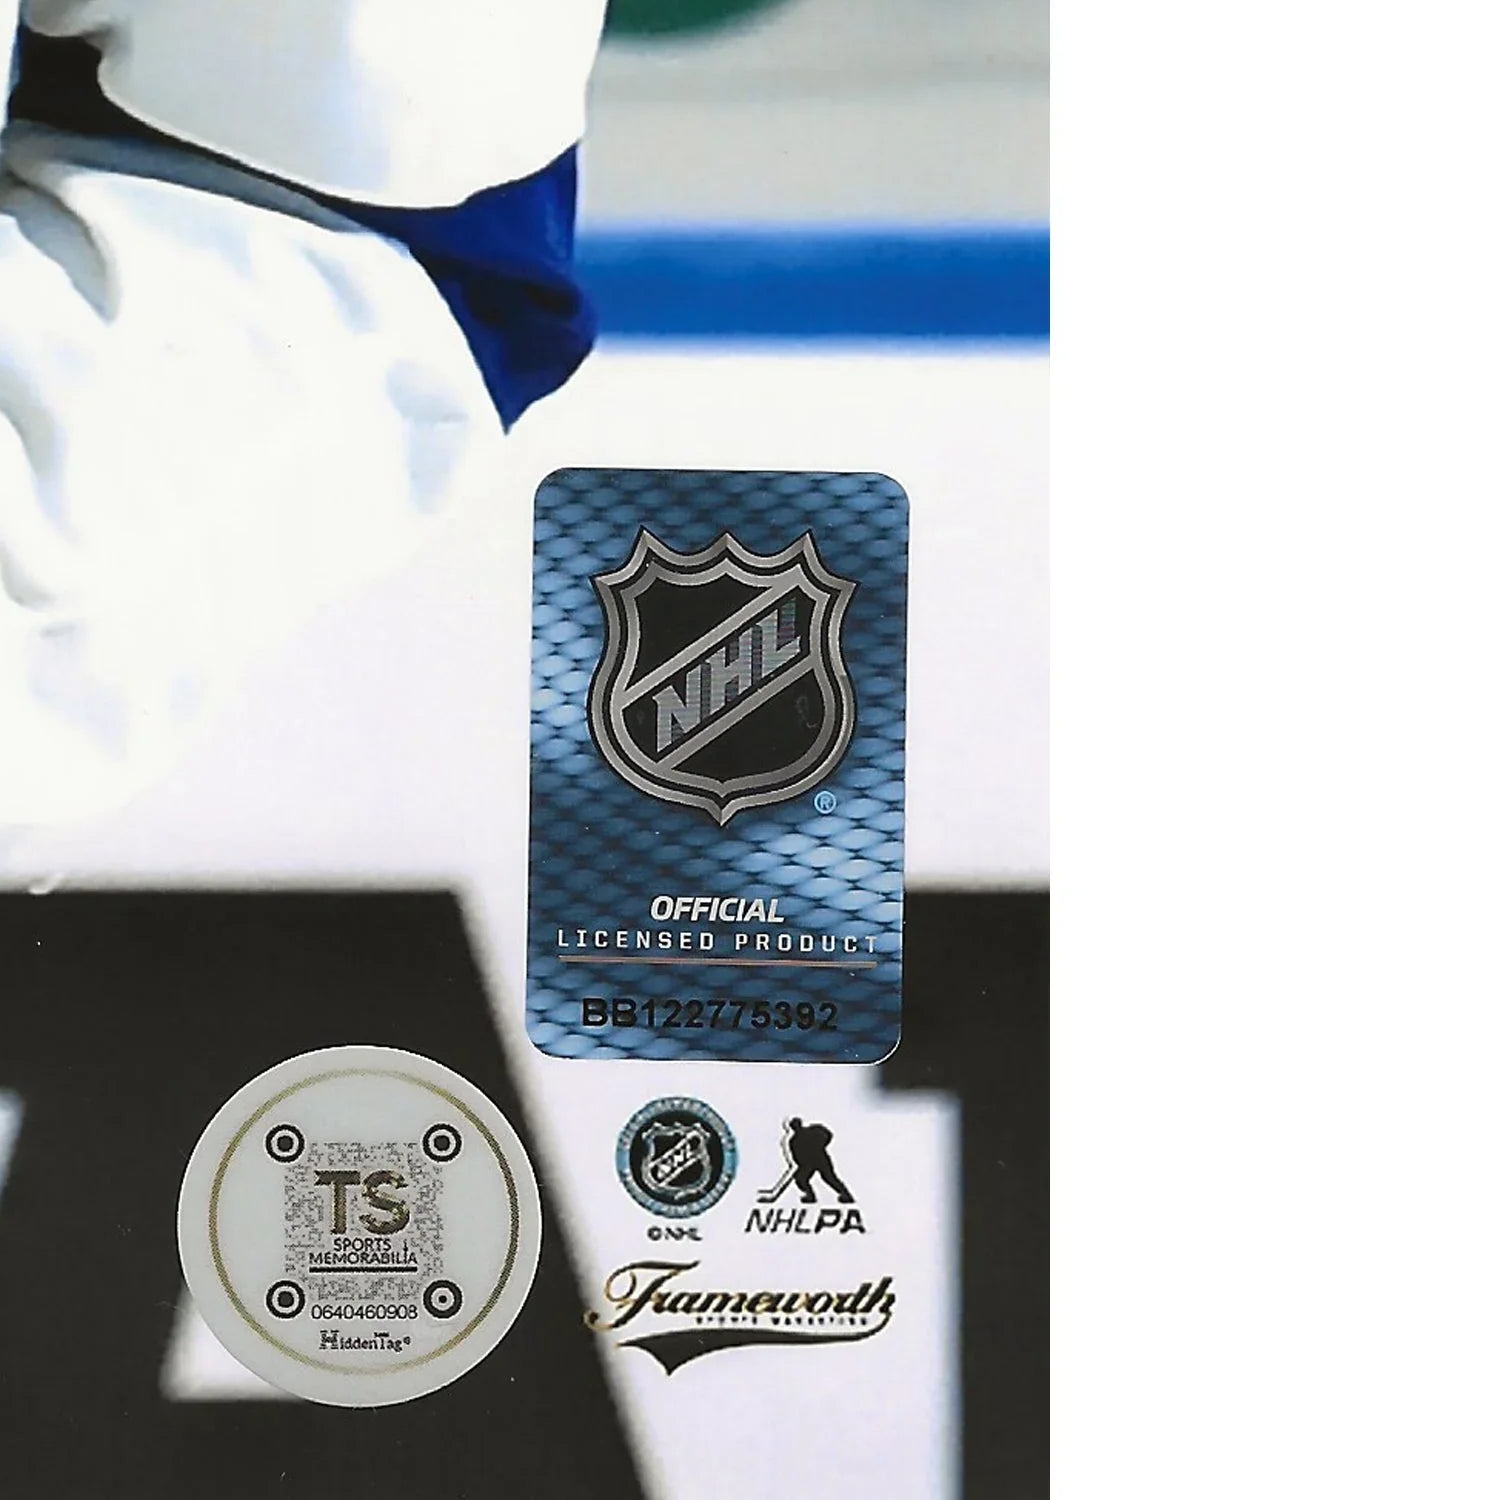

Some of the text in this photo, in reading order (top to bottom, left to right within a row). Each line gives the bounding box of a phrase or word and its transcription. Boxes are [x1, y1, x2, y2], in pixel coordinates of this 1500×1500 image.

[652, 597, 801, 753] NHL
[650, 895, 786, 923] OFFICIAL
[557, 929, 879, 954] LICENSED PRODUCT
[313, 1169, 411, 1235] TS
[332, 1237, 392, 1252] SPORTS
[308, 1251, 419, 1265] MEMORABILIA
[310, 1303, 419, 1320] 0640460908
